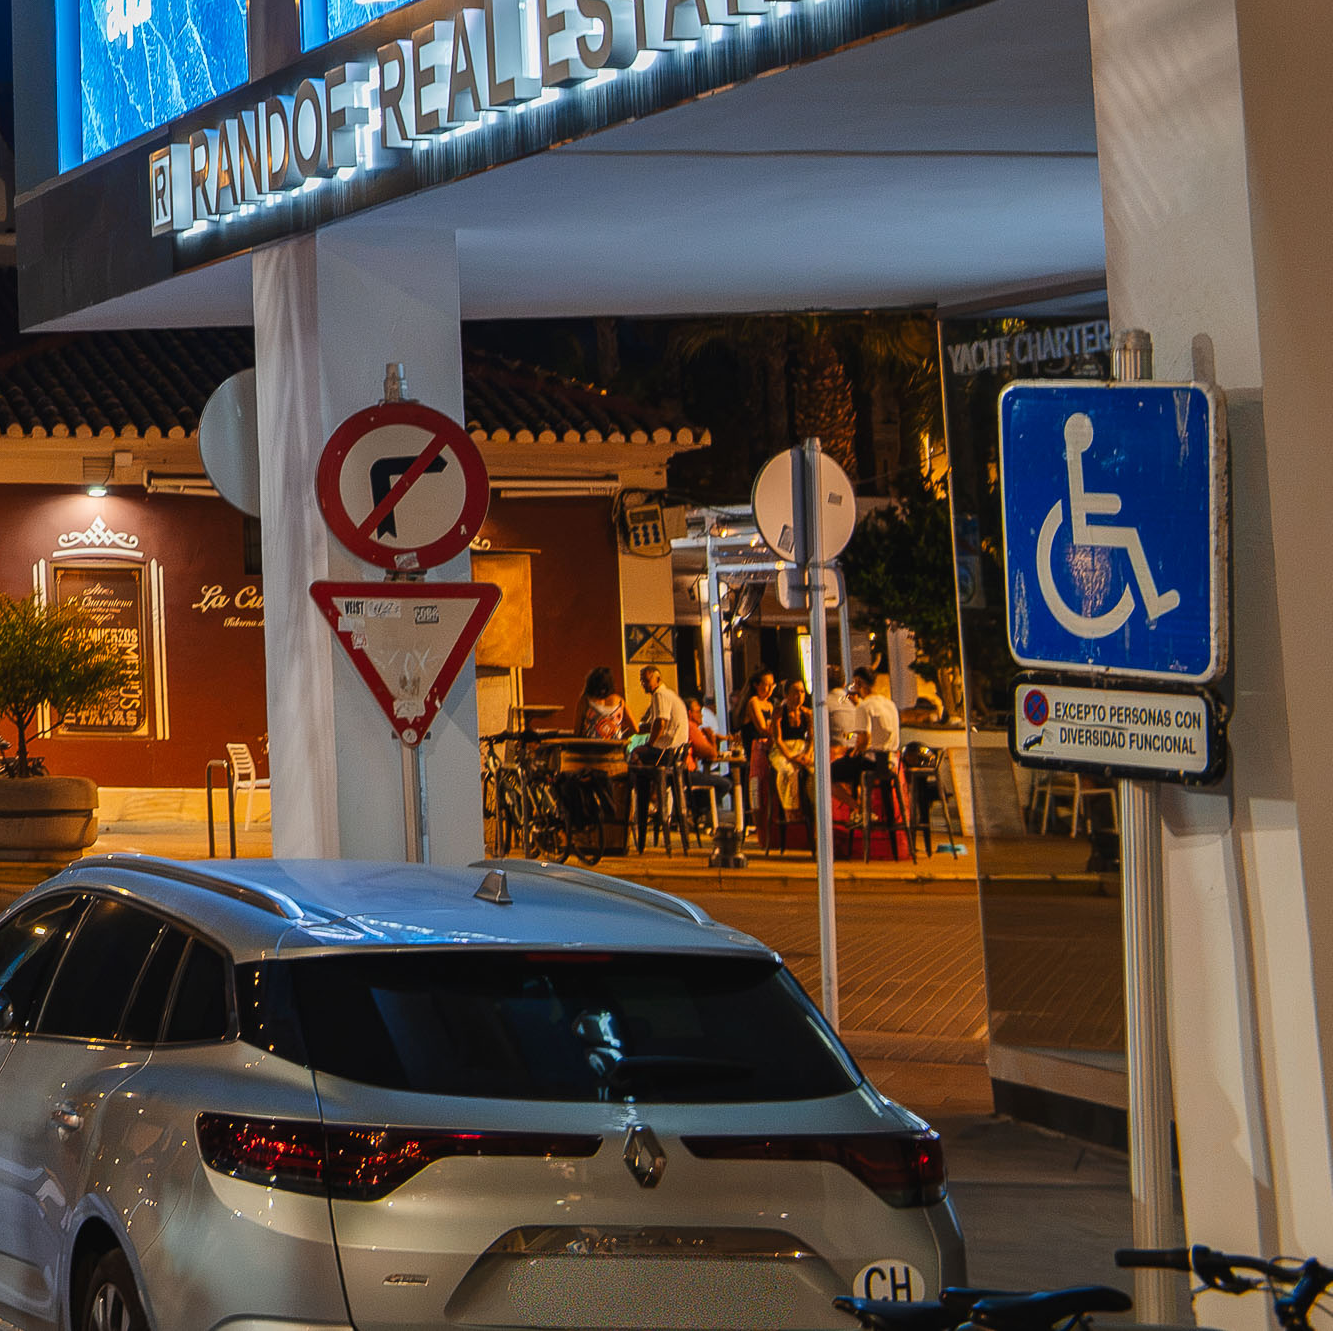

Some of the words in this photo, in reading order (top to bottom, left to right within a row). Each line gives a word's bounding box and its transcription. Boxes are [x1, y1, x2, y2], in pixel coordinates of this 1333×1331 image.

[189, 62, 351, 218] RANDOF
[947, 336, 1011, 375] YACHT
[192, 584, 231, 614] La
[1054, 701, 1106, 722] EXCEPTO
[1109, 706, 1172, 727] PERSONAS
[1175, 710, 1201, 730] CON
[1059, 727, 1126, 749] DIVERSIDAD
[1129, 732, 1196, 754] FUNCIONAL
[863, 1265, 912, 1302] CH
